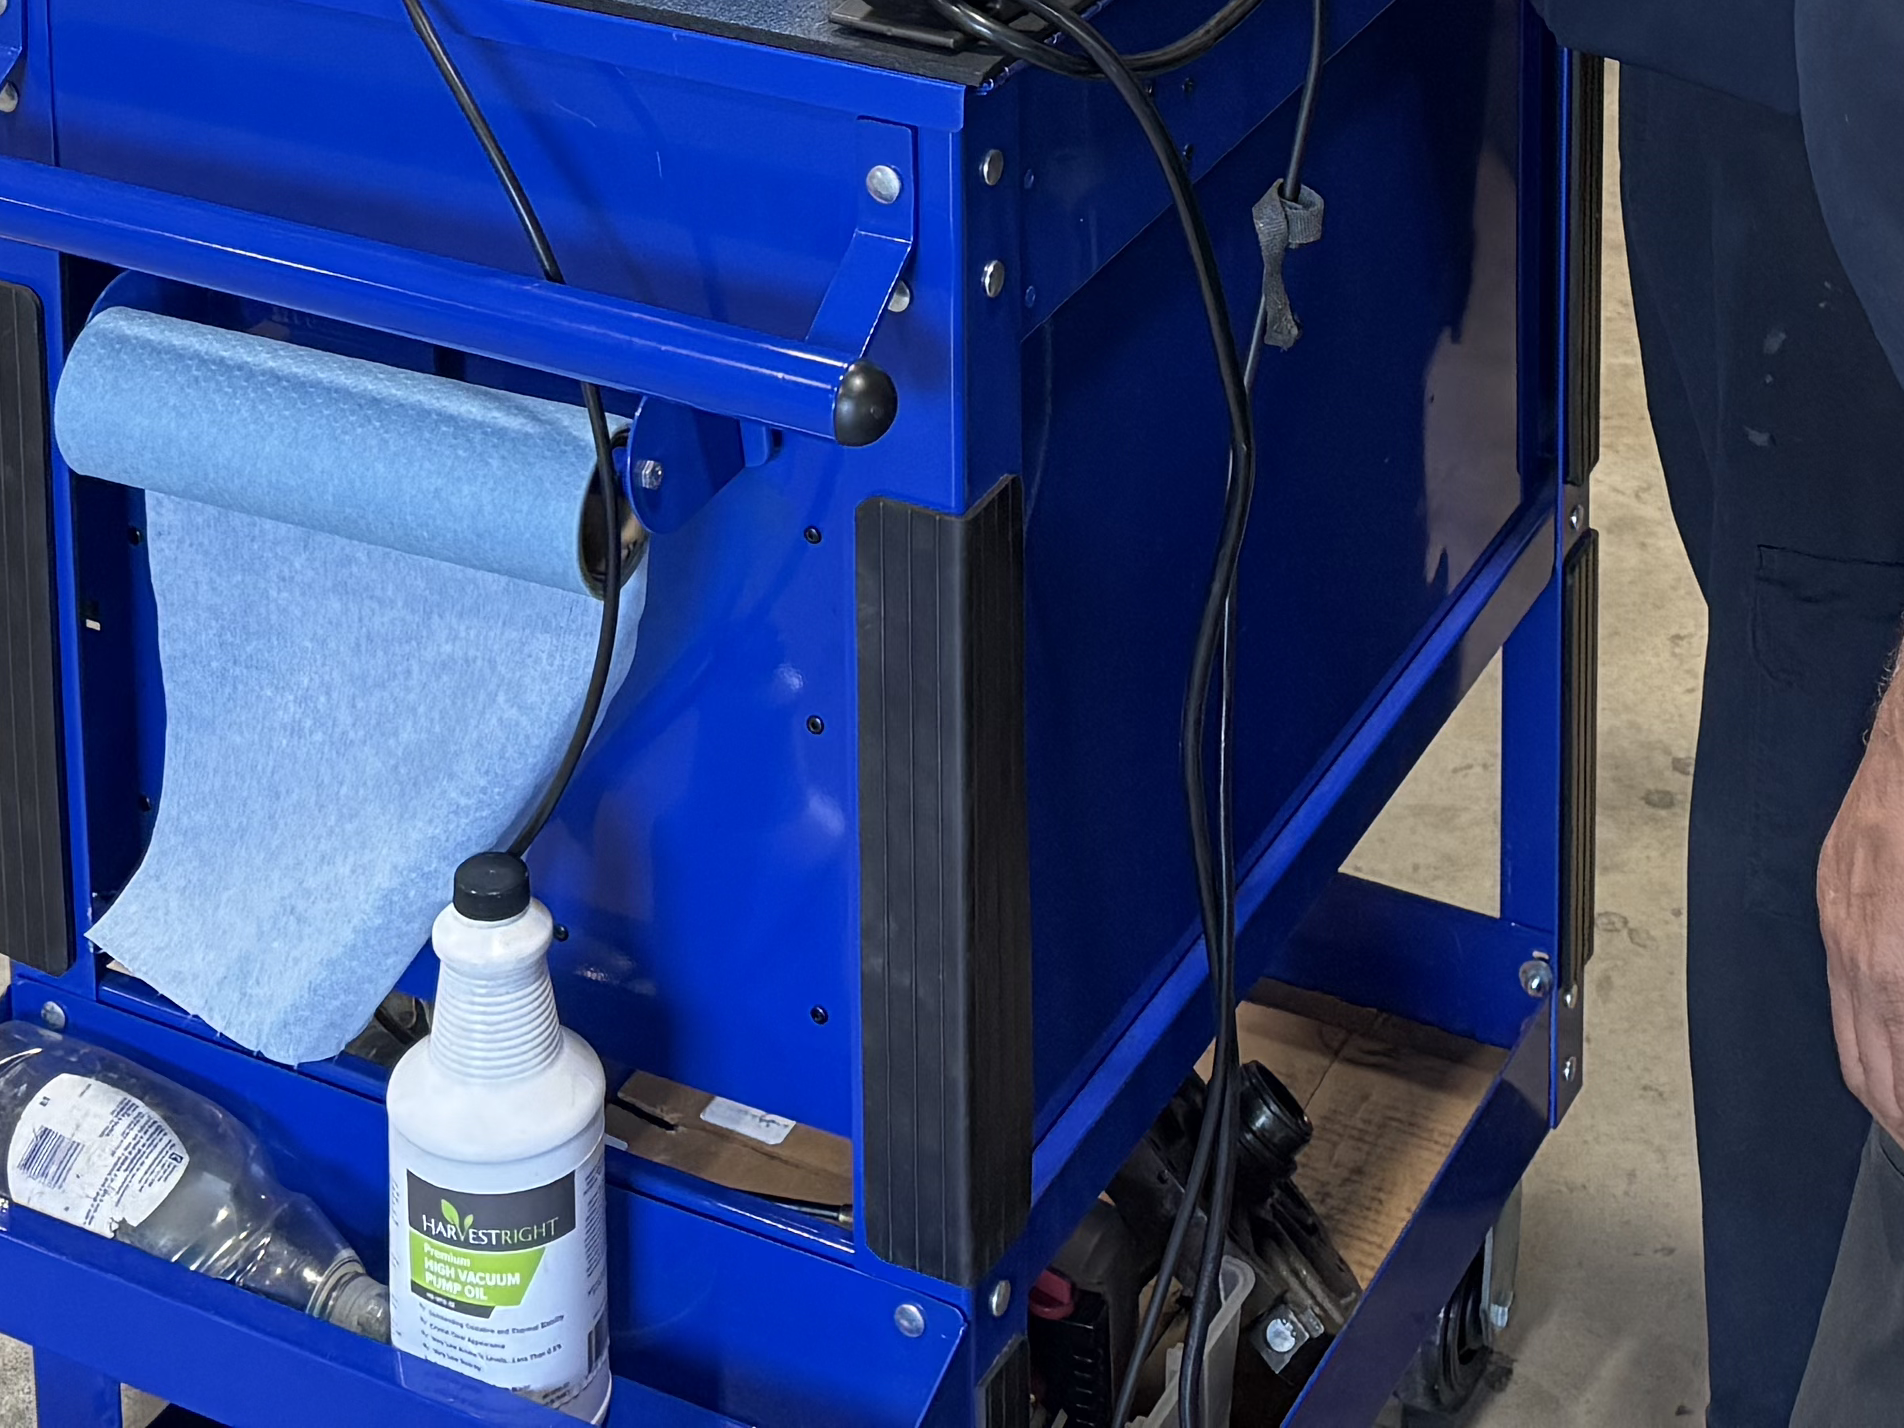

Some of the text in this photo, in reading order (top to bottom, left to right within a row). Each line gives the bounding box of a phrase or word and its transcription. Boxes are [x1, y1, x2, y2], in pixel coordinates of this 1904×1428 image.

[423, 1242, 471, 1267] Premium
[424, 1256, 520, 1286] HIGH VACUUM
[425, 1272, 462, 1293] PUMP
[464, 1286, 488, 1301] OIL
